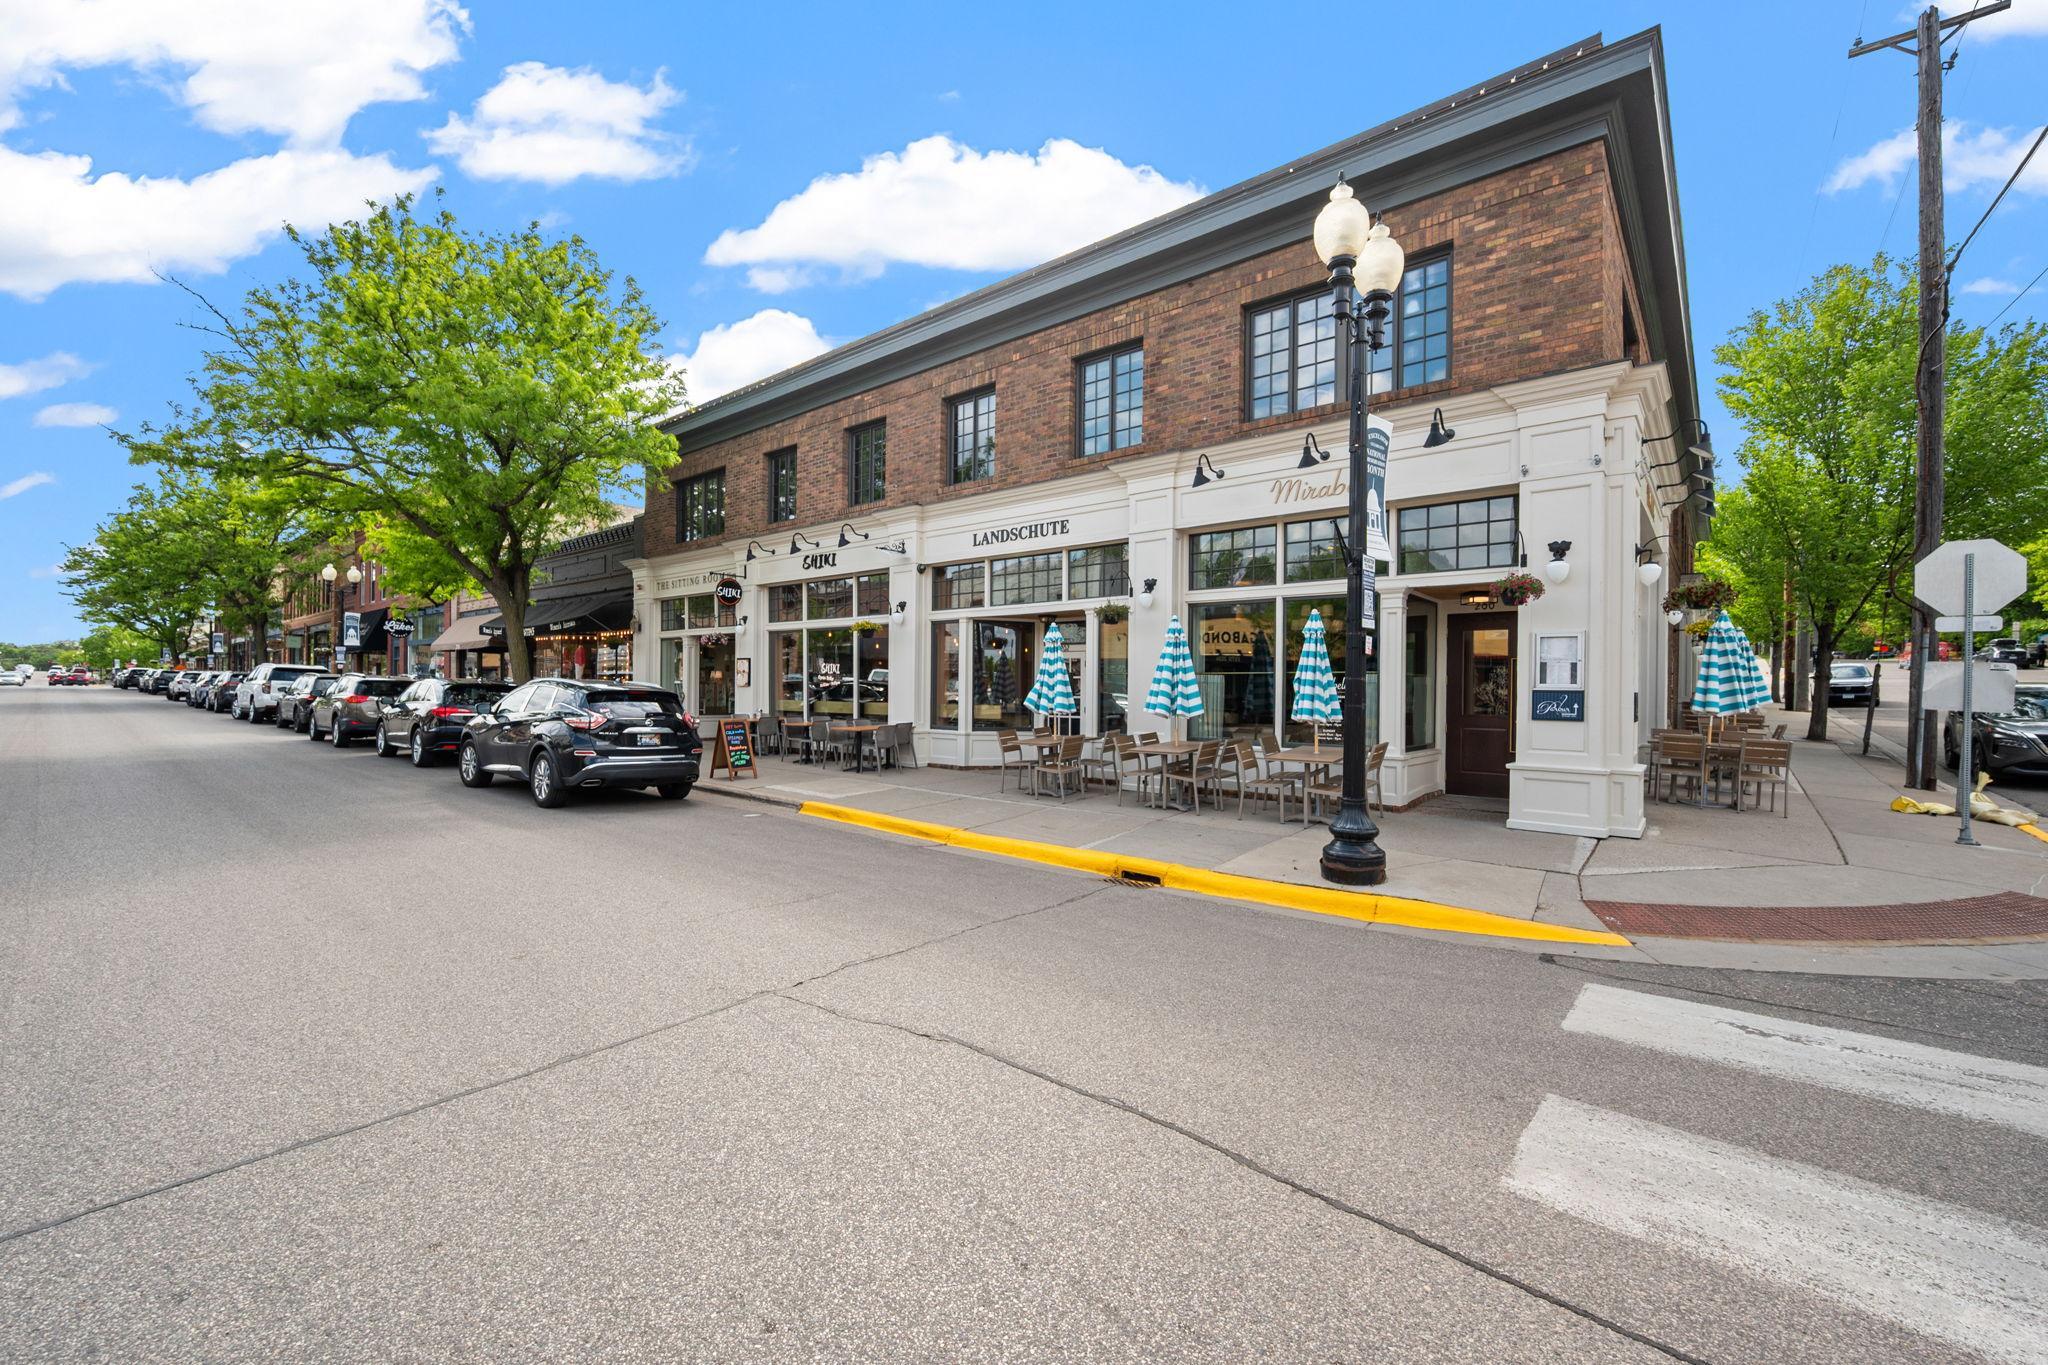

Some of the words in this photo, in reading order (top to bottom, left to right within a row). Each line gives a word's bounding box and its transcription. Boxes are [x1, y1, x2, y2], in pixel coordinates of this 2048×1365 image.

[1270, 468, 1351, 505] Mirab
[972, 519, 1070, 547] LANDSCHUTE
[802, 552, 837, 570] SHIKI
[656, 581, 670, 592] THE
[671, 576, 700, 589] SITTING
[717, 586, 741, 599] SHIKI
[383, 620, 416, 632] Lakes
[820, 662, 841, 675] SHIKI
